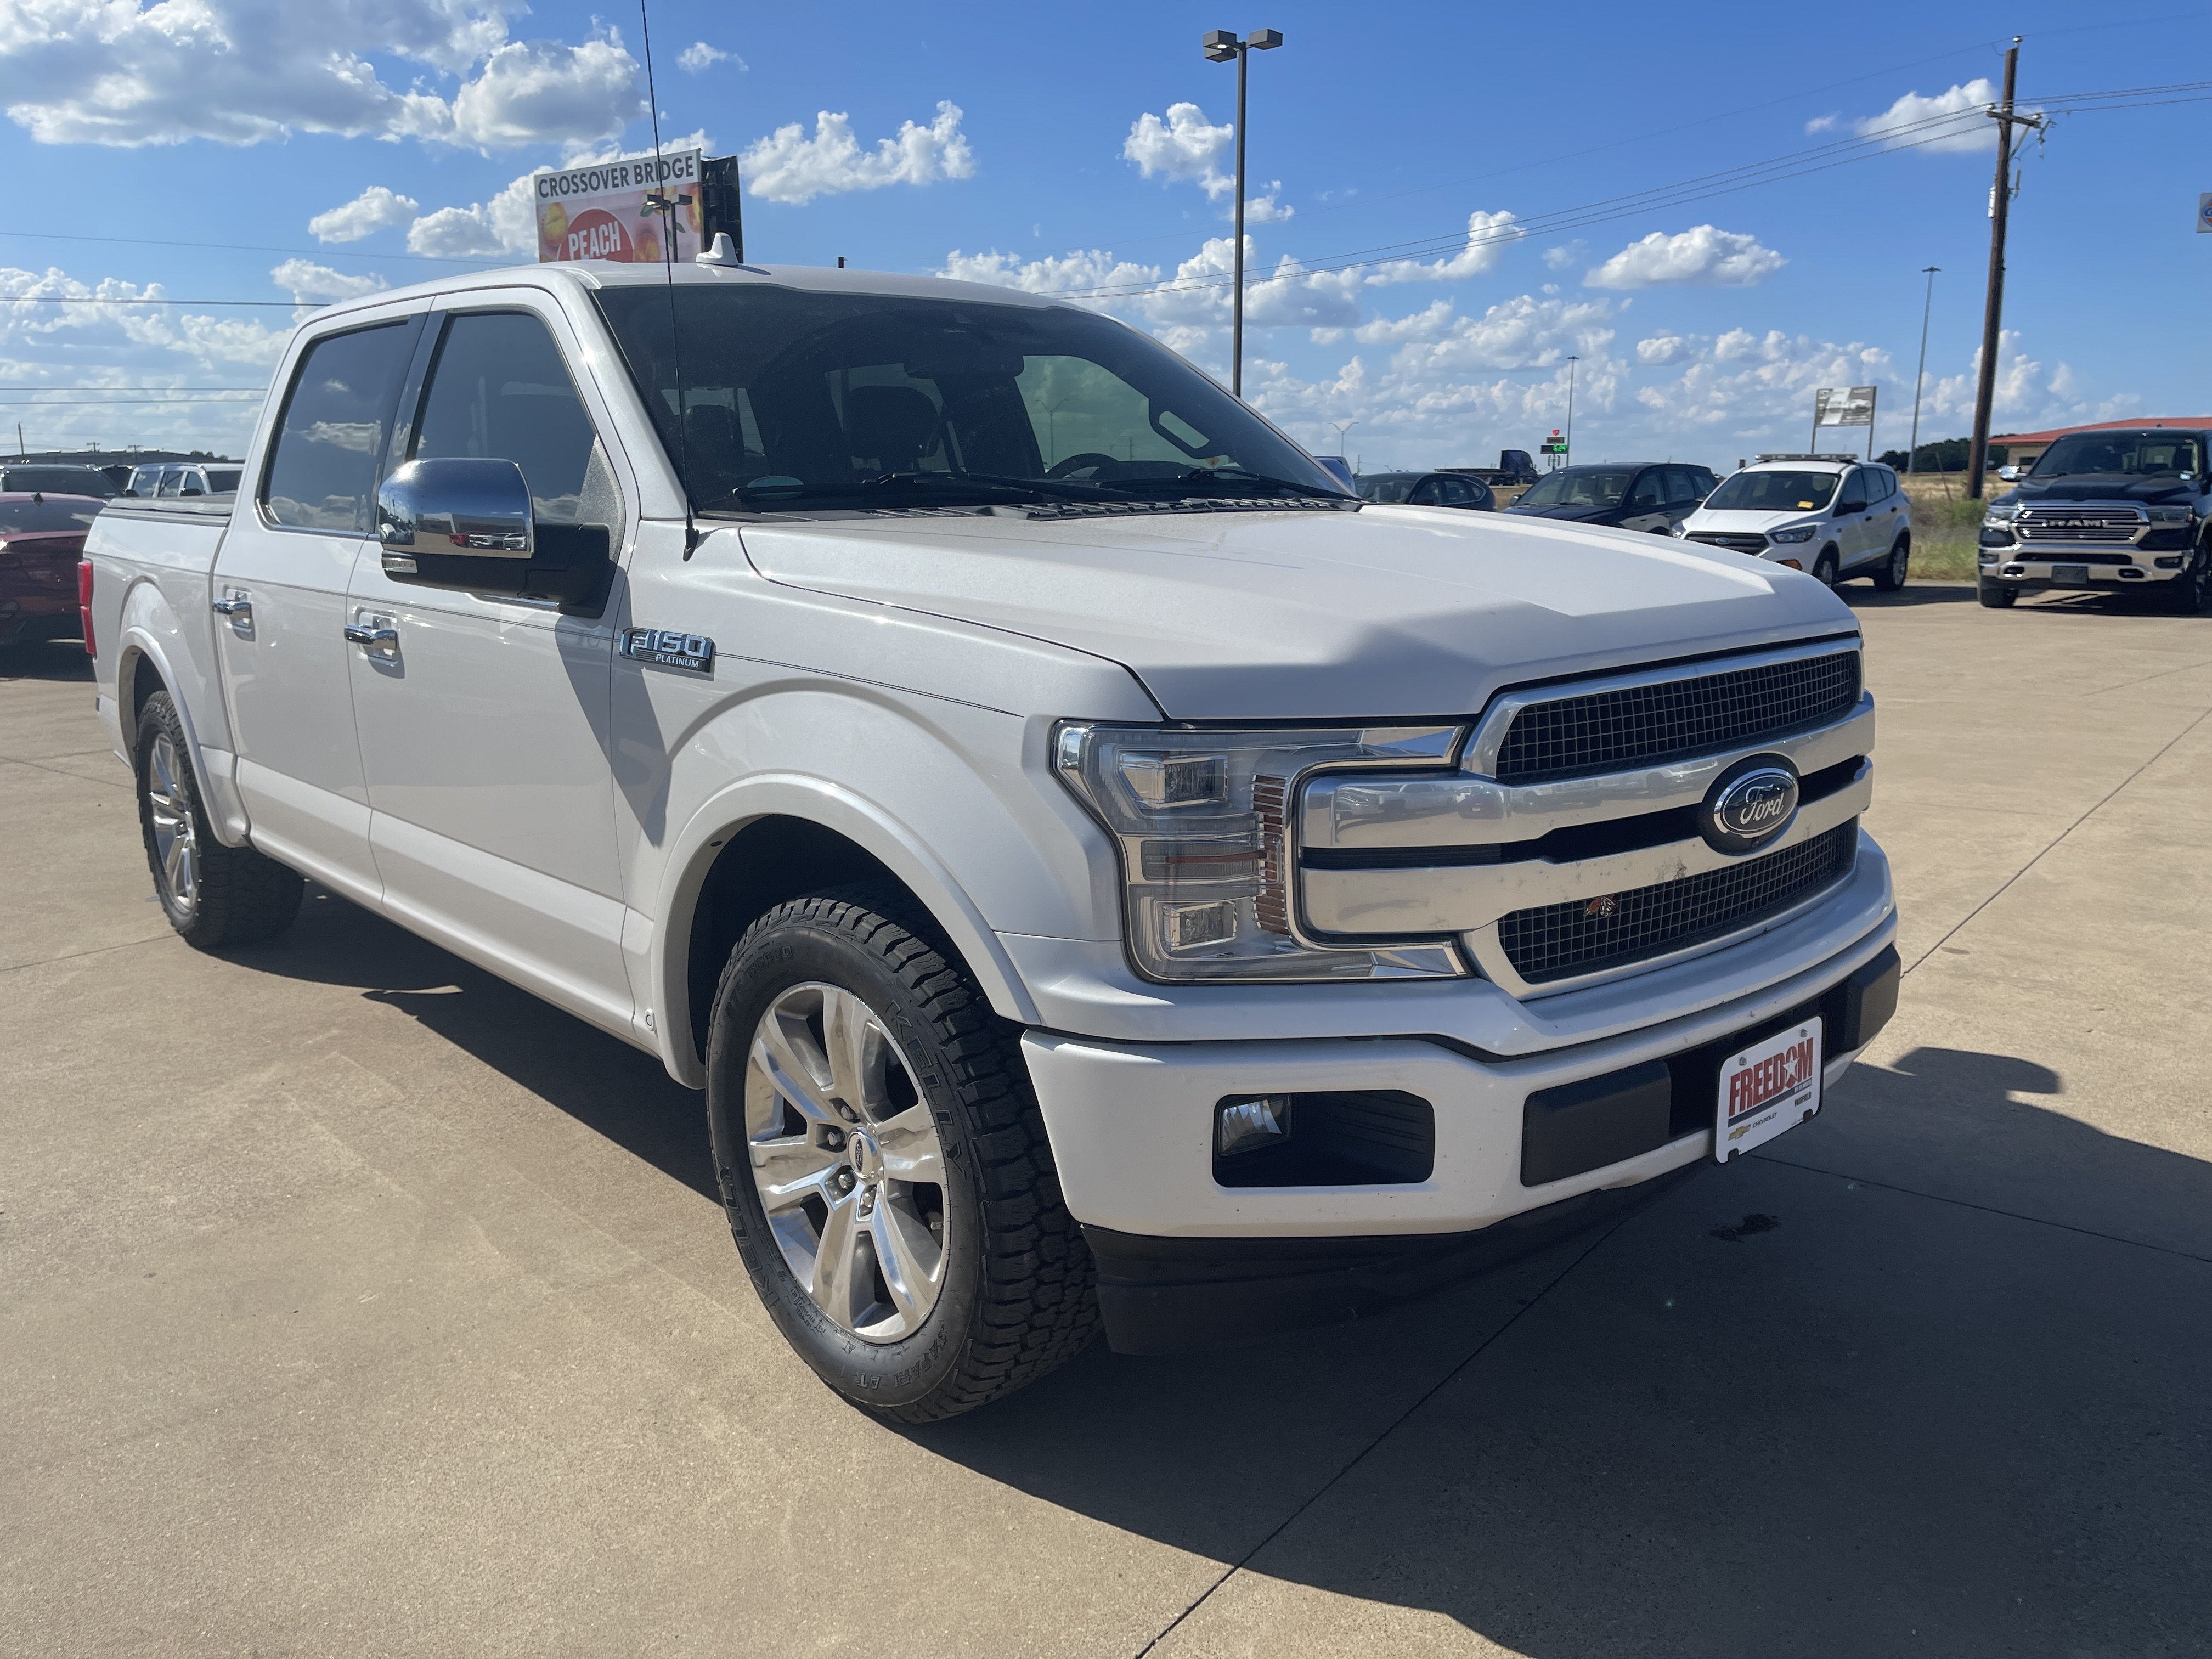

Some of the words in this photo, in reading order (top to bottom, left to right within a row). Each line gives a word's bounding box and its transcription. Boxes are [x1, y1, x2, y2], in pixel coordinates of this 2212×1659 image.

[539, 166, 629, 198] CROSSOVER
[634, 156, 693, 185] BRIDGE
[568, 221, 621, 260] PEACH
[656, 654, 699, 668] PLATINUM
[1740, 783, 1785, 825] Ford
[885, 999, 967, 1180] KELLY
[1729, 1037, 1814, 1118] FREEDOM
[1753, 1111, 1778, 1128] CHEVROLET
[894, 1324, 947, 1388] SAFARI
